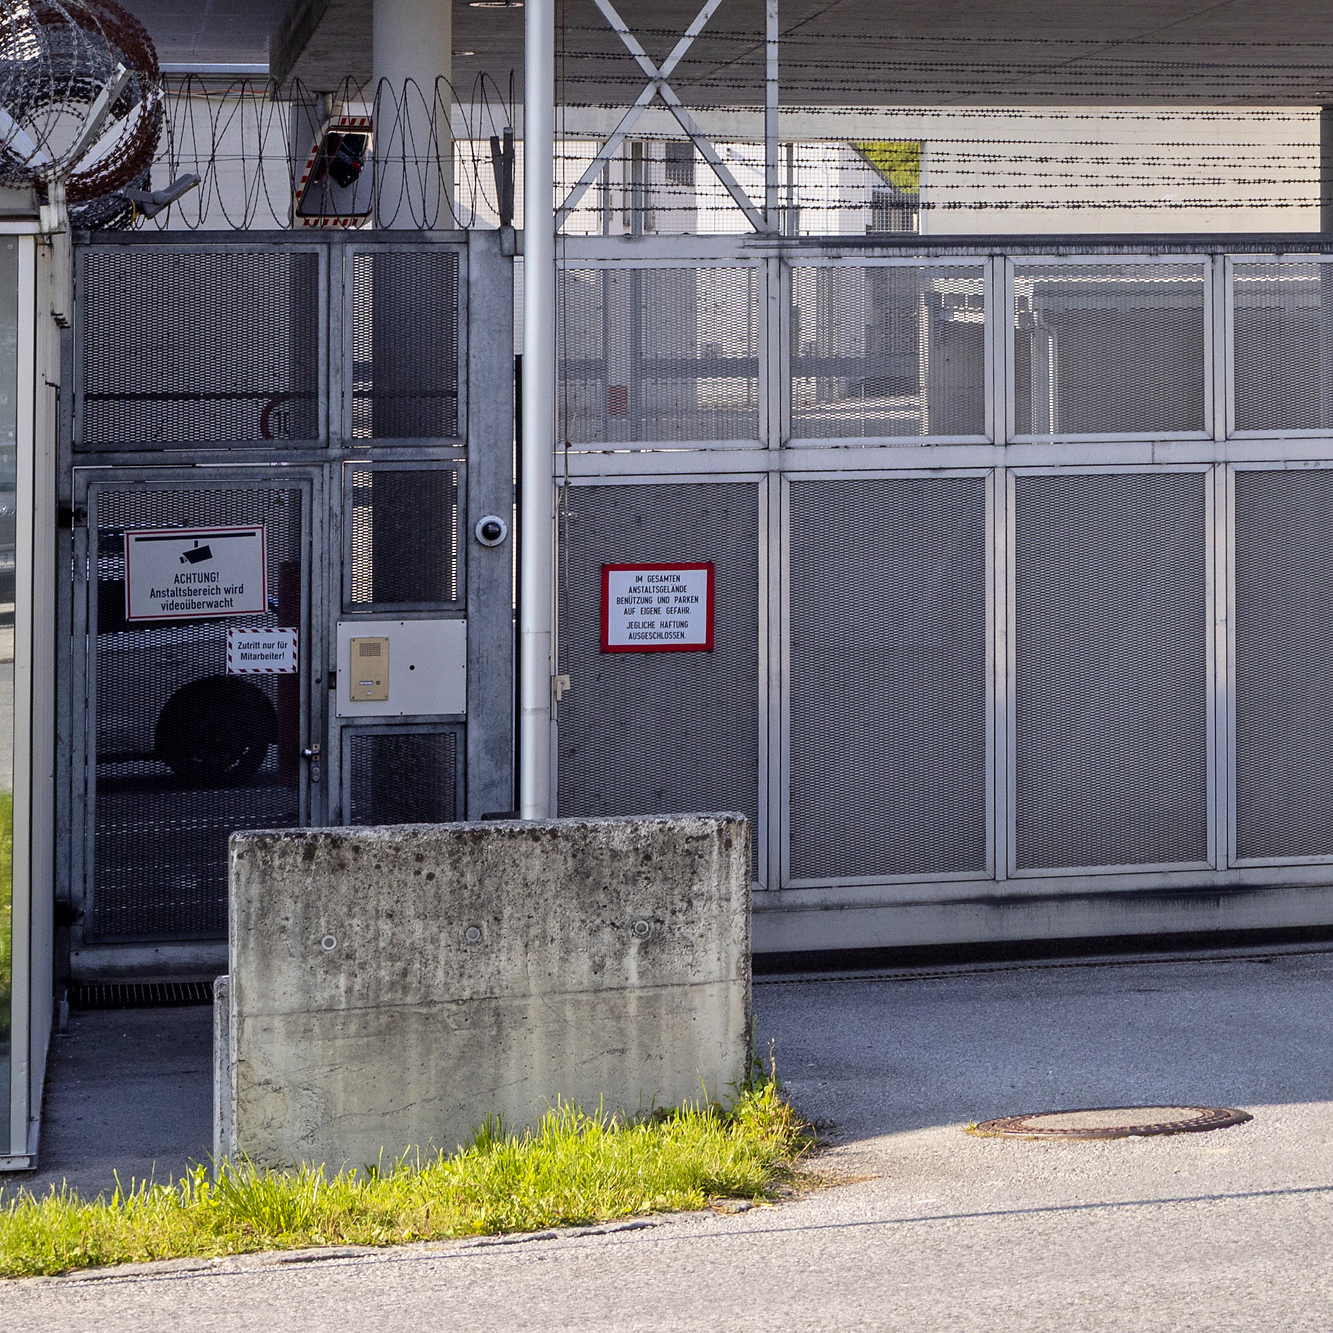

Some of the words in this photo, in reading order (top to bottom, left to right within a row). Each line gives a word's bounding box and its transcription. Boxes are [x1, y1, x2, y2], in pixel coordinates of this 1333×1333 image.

[173, 571, 220, 585] ACHTUNG!
[635, 575, 643, 583] IM
[647, 574, 681, 583] GESAMTEN
[149, 584, 222, 599] Anstaltsbereich
[223, 583, 244, 595] wird
[628, 583, 688, 594] ANSTALTSGELÄNDE
[160, 597, 234, 611] videoüberwacht
[616, 594, 653, 605] BENÜTZUNG
[674, 595, 699, 604] PARKEN
[623, 608, 636, 616] AUF
[640, 607, 661, 616] EIGENE
[665, 606, 692, 615] GEFAHR.
[626, 621, 655, 630] JEGLICHE
[659, 620, 689, 629] HAFTUNG
[628, 631, 687, 641] AUSGESCHLOSSEN.
[237, 641, 261, 650] Zutritt
[262, 641, 275, 649] nur
[277, 640, 288, 649] für
[240, 651, 285, 661] Mitarbeiter!
